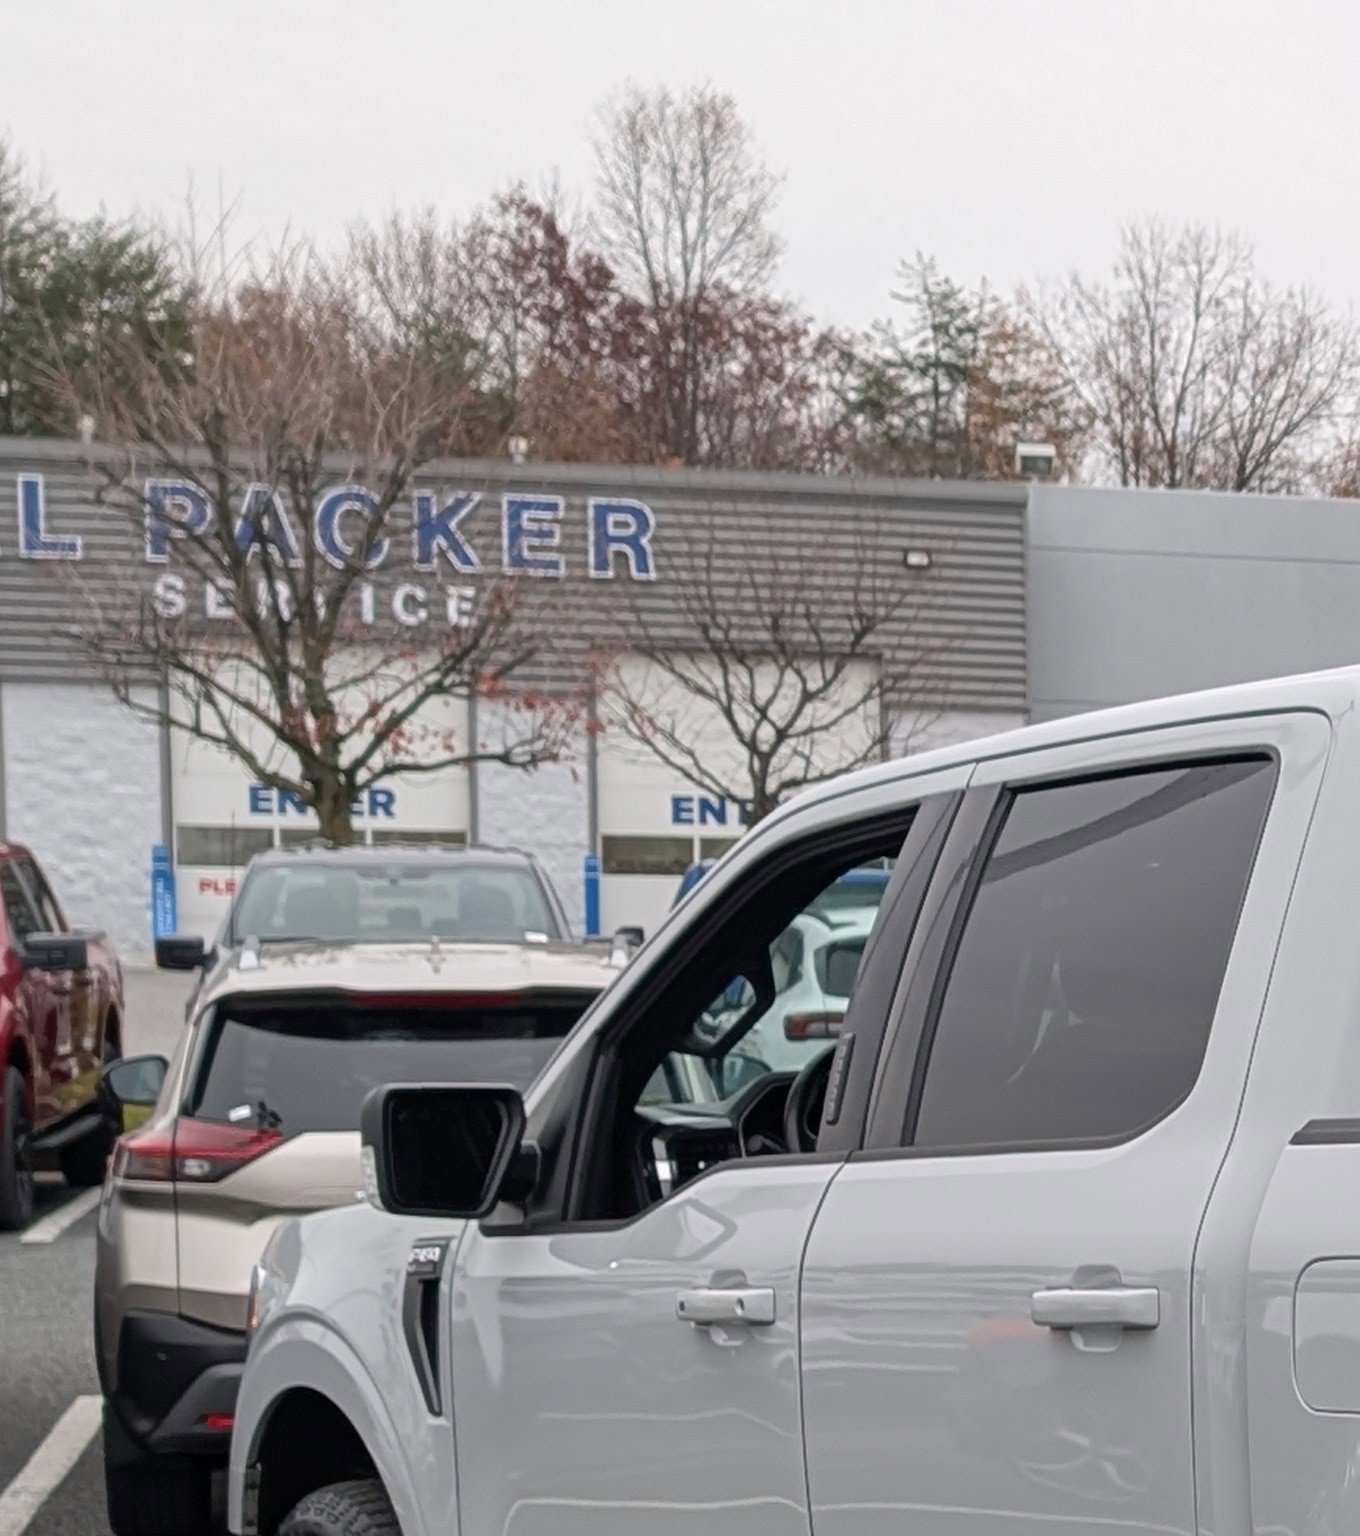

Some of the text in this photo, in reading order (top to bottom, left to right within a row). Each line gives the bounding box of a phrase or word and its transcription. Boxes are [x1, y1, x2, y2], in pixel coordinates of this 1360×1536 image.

[18, 472, 657, 580] L PACKER
[249, 786, 396, 819] ENER
